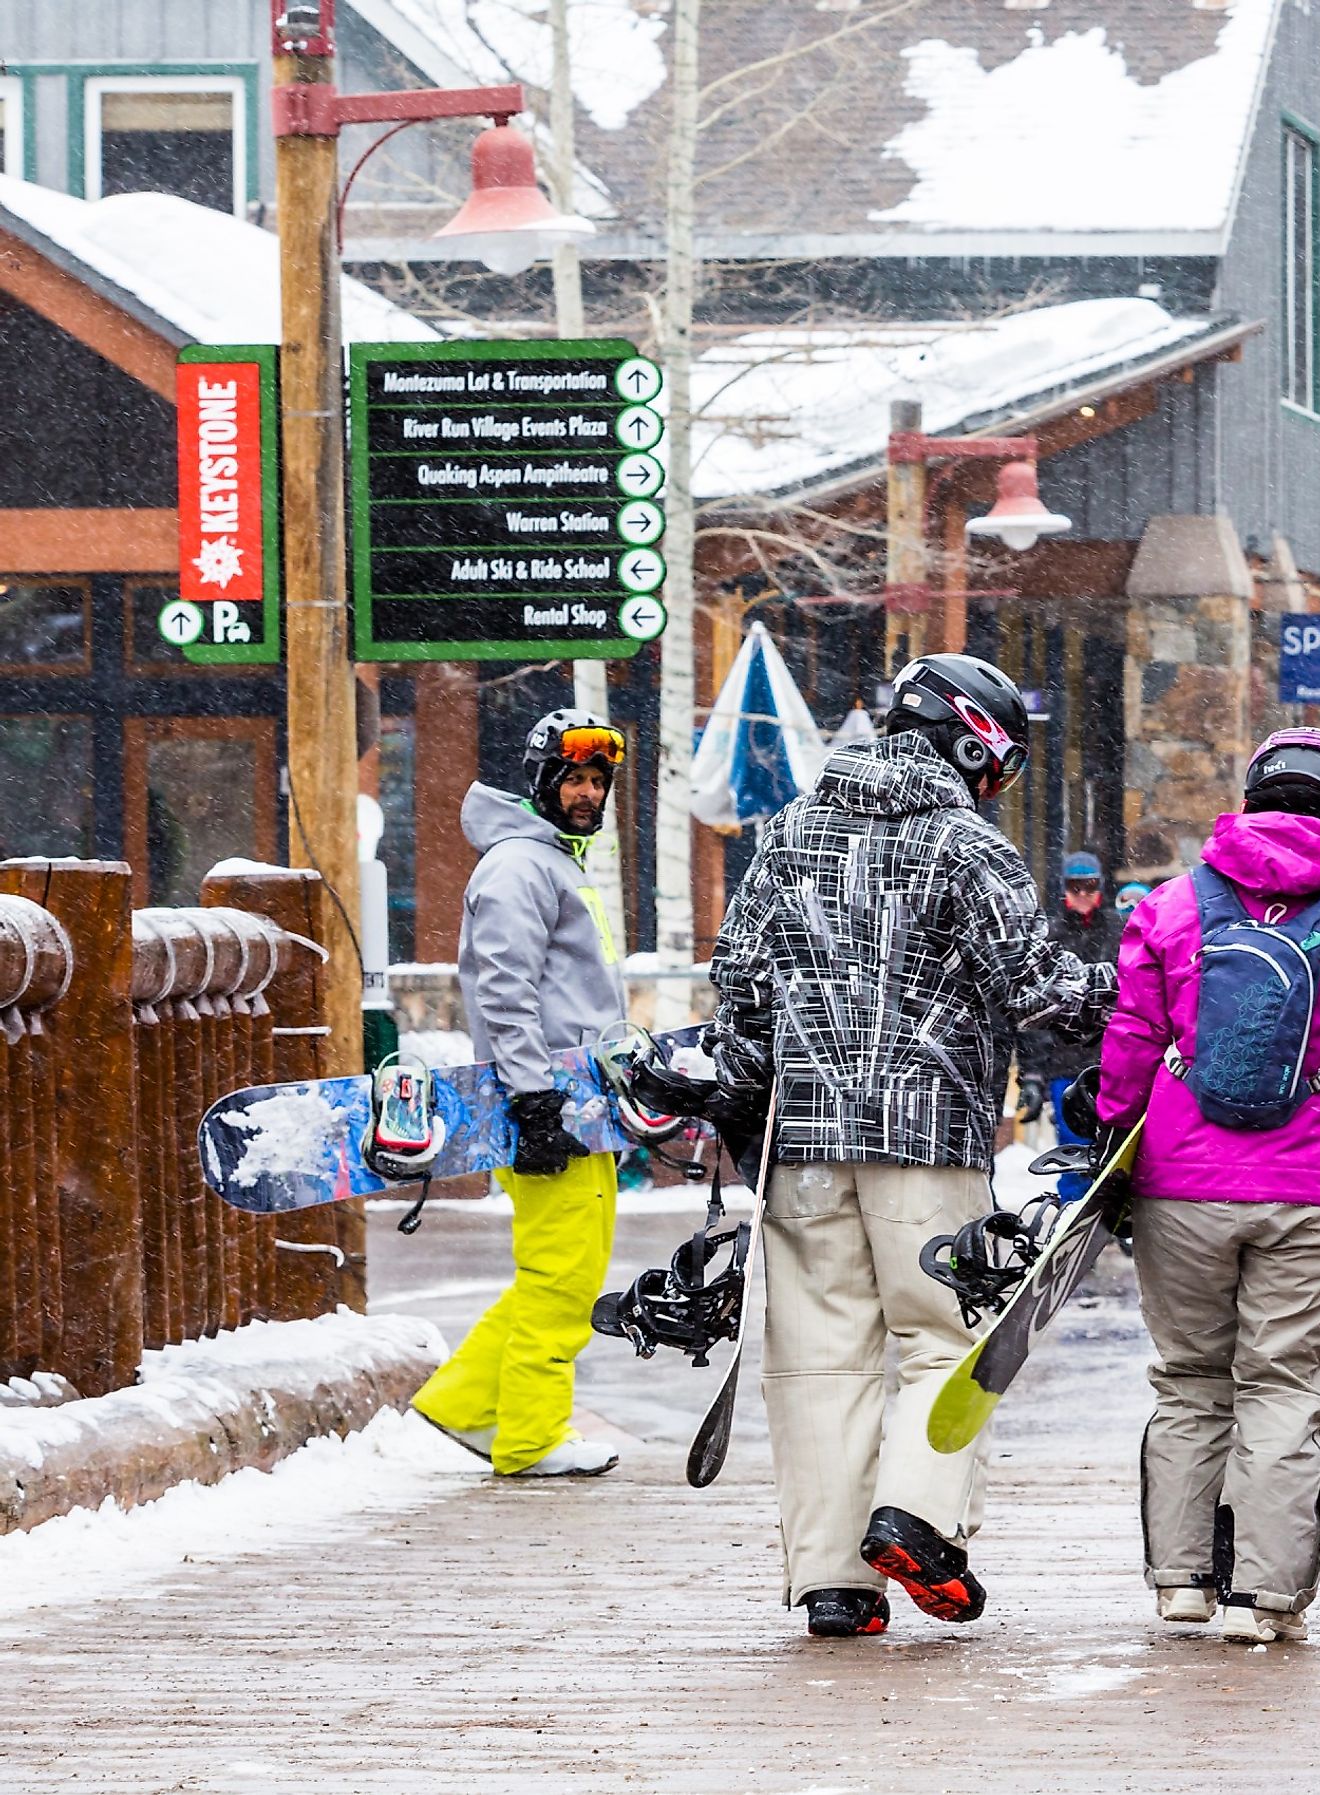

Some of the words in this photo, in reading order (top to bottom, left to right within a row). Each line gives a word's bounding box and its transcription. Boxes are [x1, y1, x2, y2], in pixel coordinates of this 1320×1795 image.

[384, 372, 465, 392] Montezuma
[467, 371, 490, 391] Lot
[492, 371, 505, 391] &
[507, 371, 607, 394] Transportation
[403, 418, 440, 438] River
[441, 417, 470, 438] Run
[472, 415, 520, 441] Village
[522, 417, 567, 437] Events
[569, 415, 608, 436] Plaza
[198, 376, 239, 532] KEYSTONE
[418, 463, 478, 488] Quaking
[479, 464, 522, 487] Aspen
[523, 462, 609, 488] Ampitheatre
[506, 512, 559, 532] Warren
[560, 511, 610, 532] Station
[451, 558, 489, 581] Adult
[490, 558, 513, 580] Ski
[515, 559, 529, 580] &
[530, 558, 563, 579] Ride
[564, 557, 610, 579] School
[212, 601, 239, 643] P
[523, 604, 569, 625] Rental
[571, 605, 607, 628] Shop
